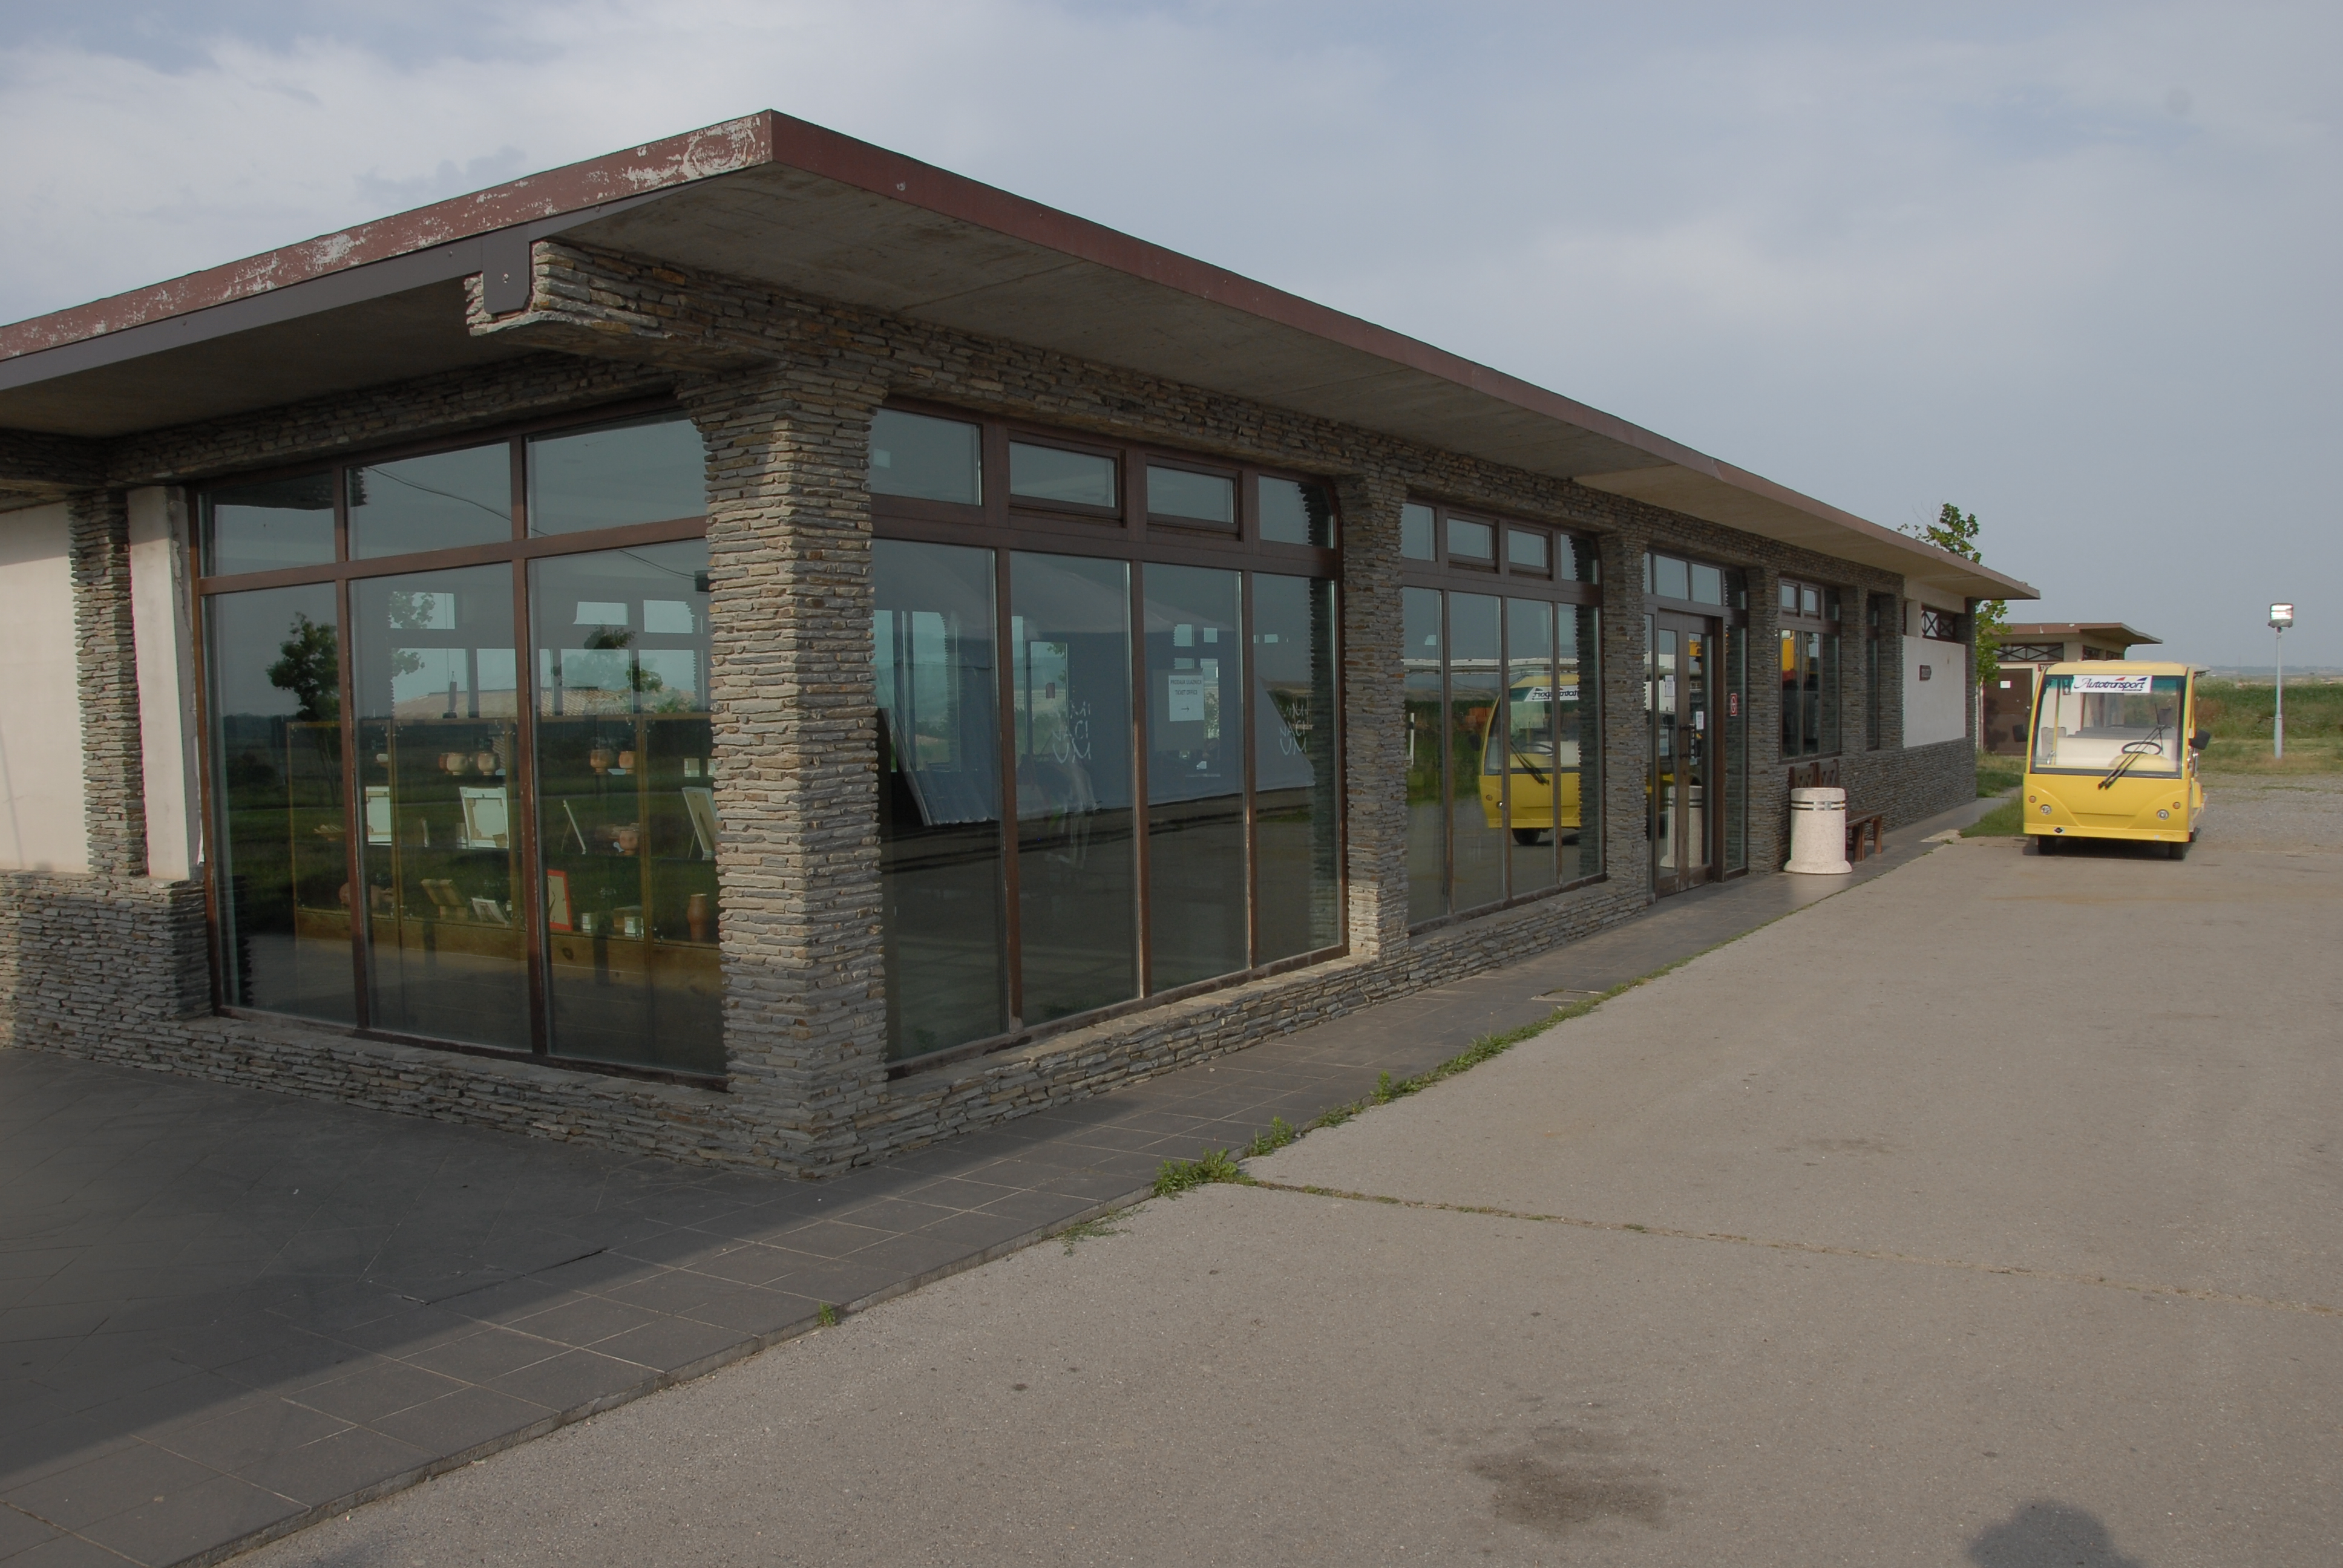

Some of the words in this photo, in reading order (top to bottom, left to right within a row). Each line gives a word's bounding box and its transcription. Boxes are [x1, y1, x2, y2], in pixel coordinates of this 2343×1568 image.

[2074, 678, 2146, 691] Autotransport
[1052, 737, 1091, 763] UM
[1279, 737, 1307, 756] UM
